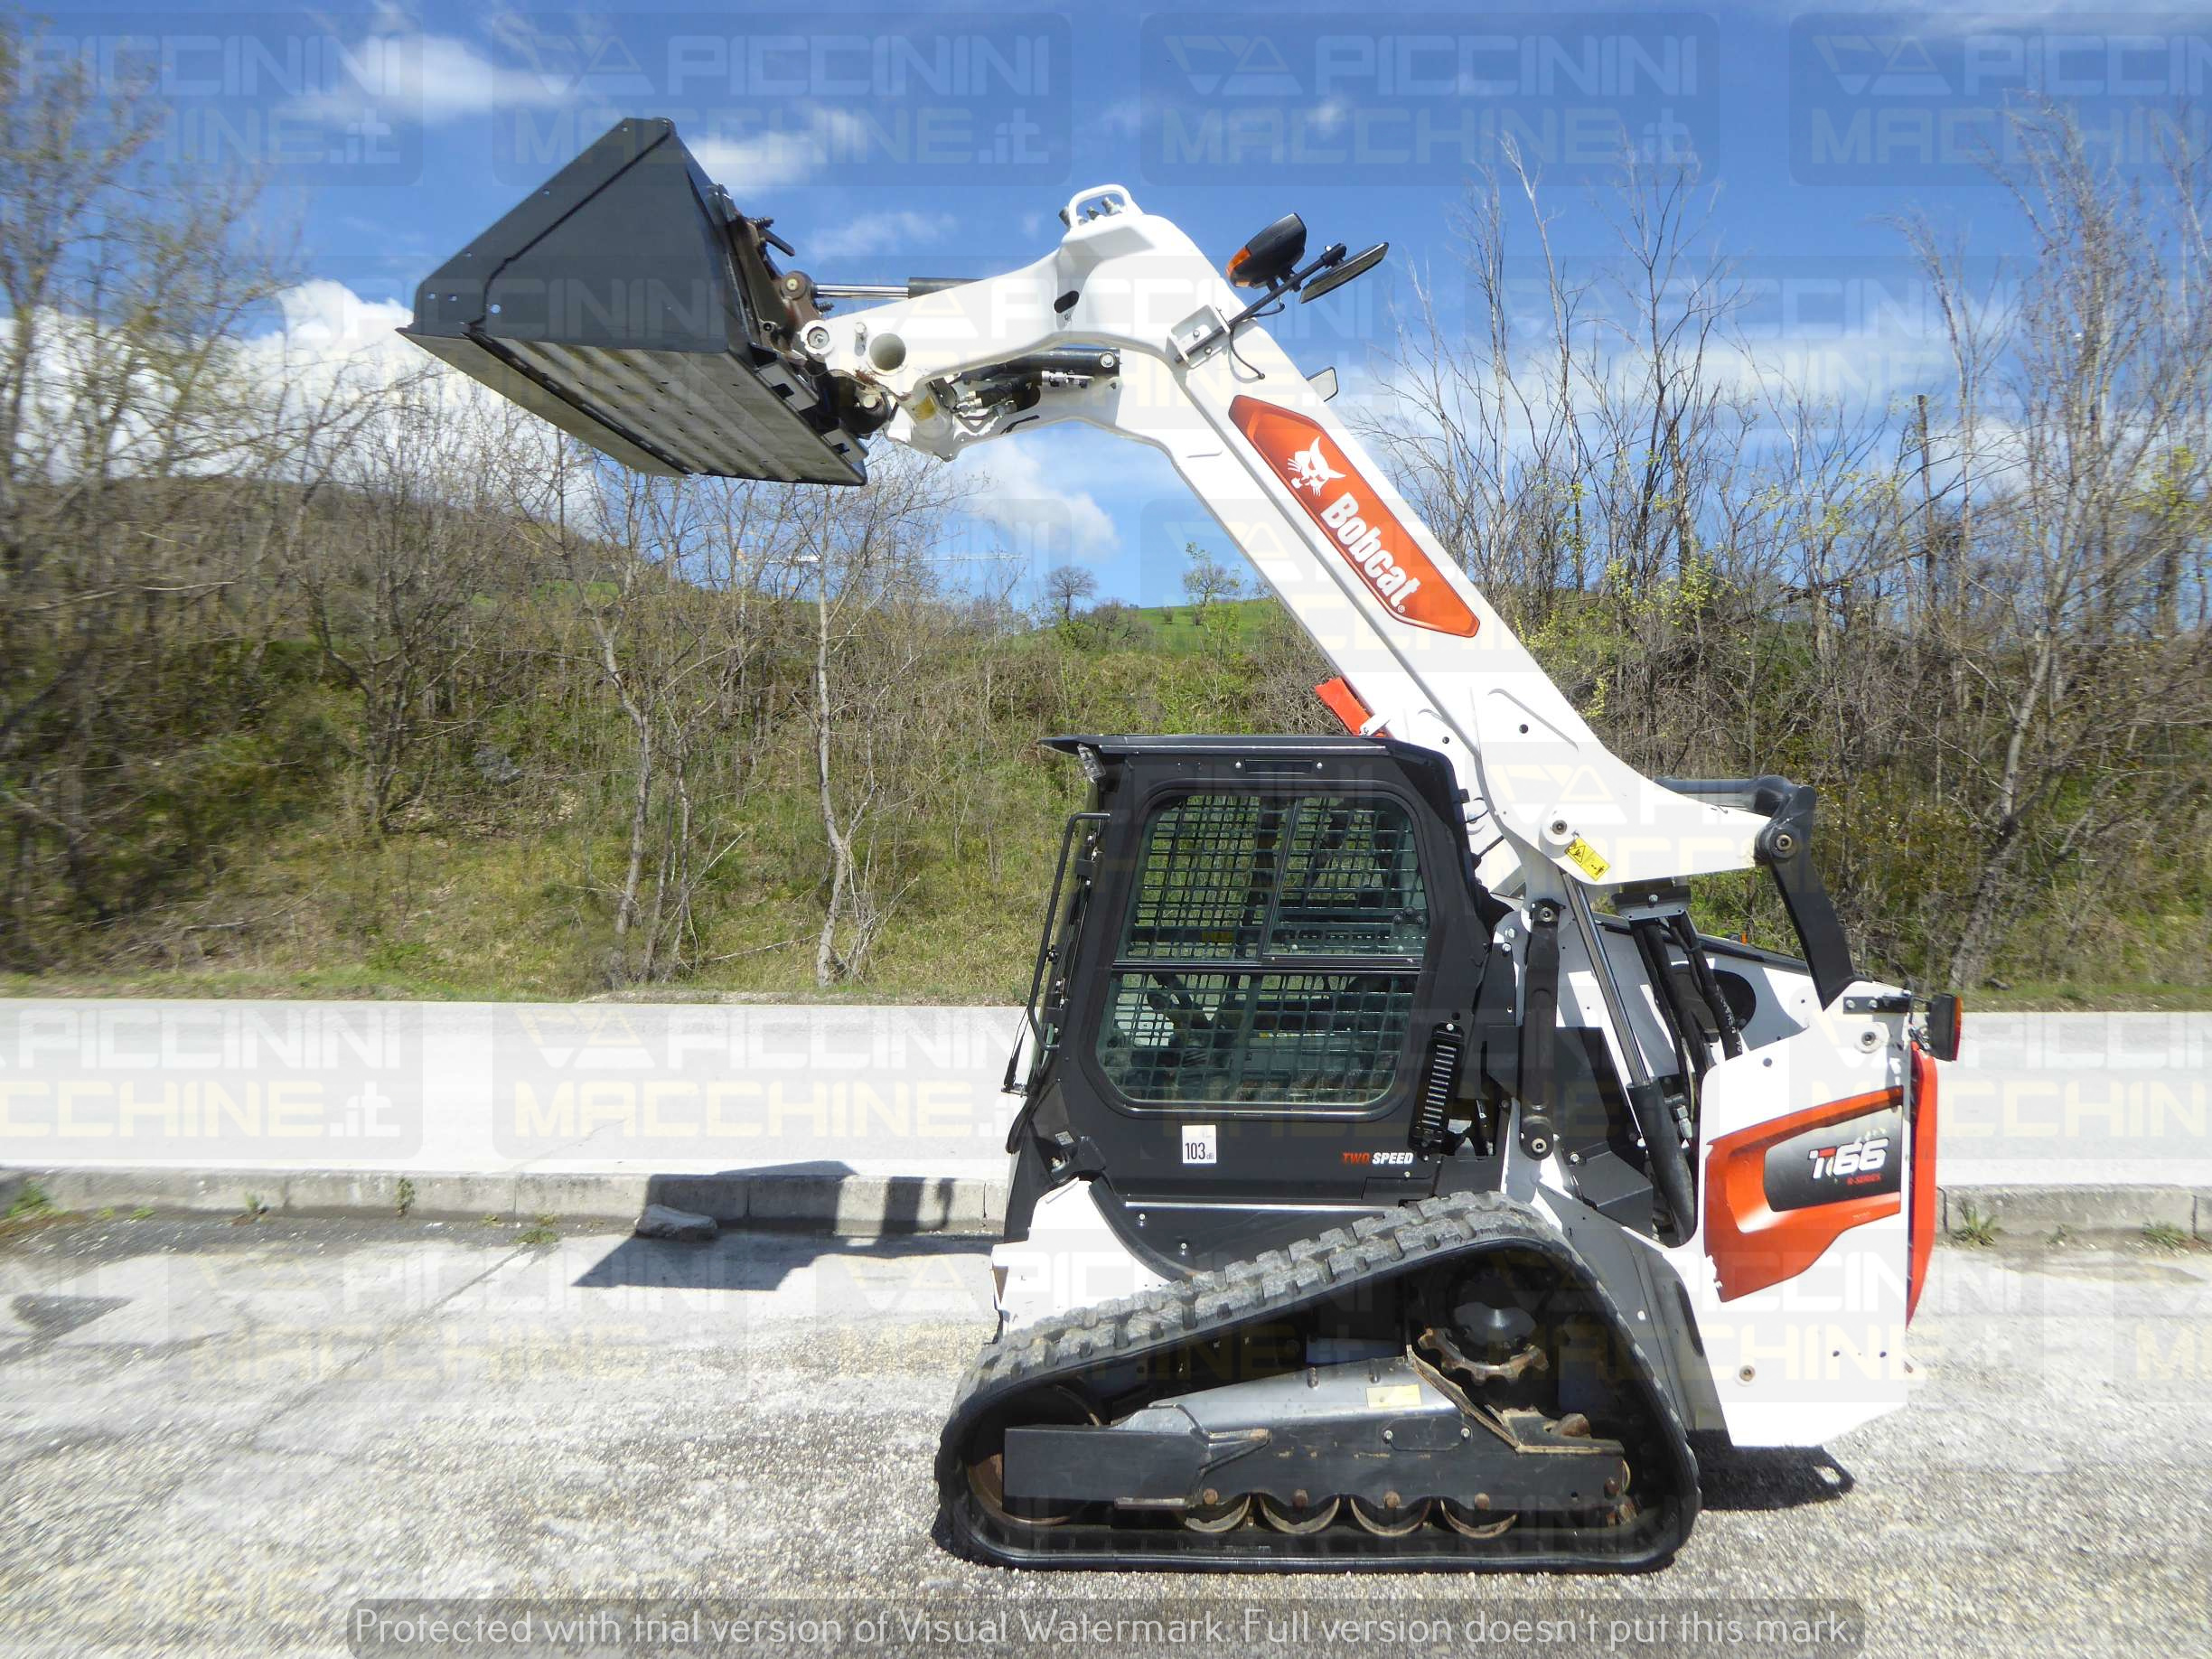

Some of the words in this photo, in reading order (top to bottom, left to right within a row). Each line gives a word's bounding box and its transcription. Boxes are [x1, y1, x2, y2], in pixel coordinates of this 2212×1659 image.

[1320, 492, 1421, 608] Bobcat
[1186, 1141, 1205, 1160] 103
[1342, 1152, 1371, 1165] TWO
[1372, 1152, 1414, 1165] SPEED
[1808, 1138, 1889, 1179] T66
